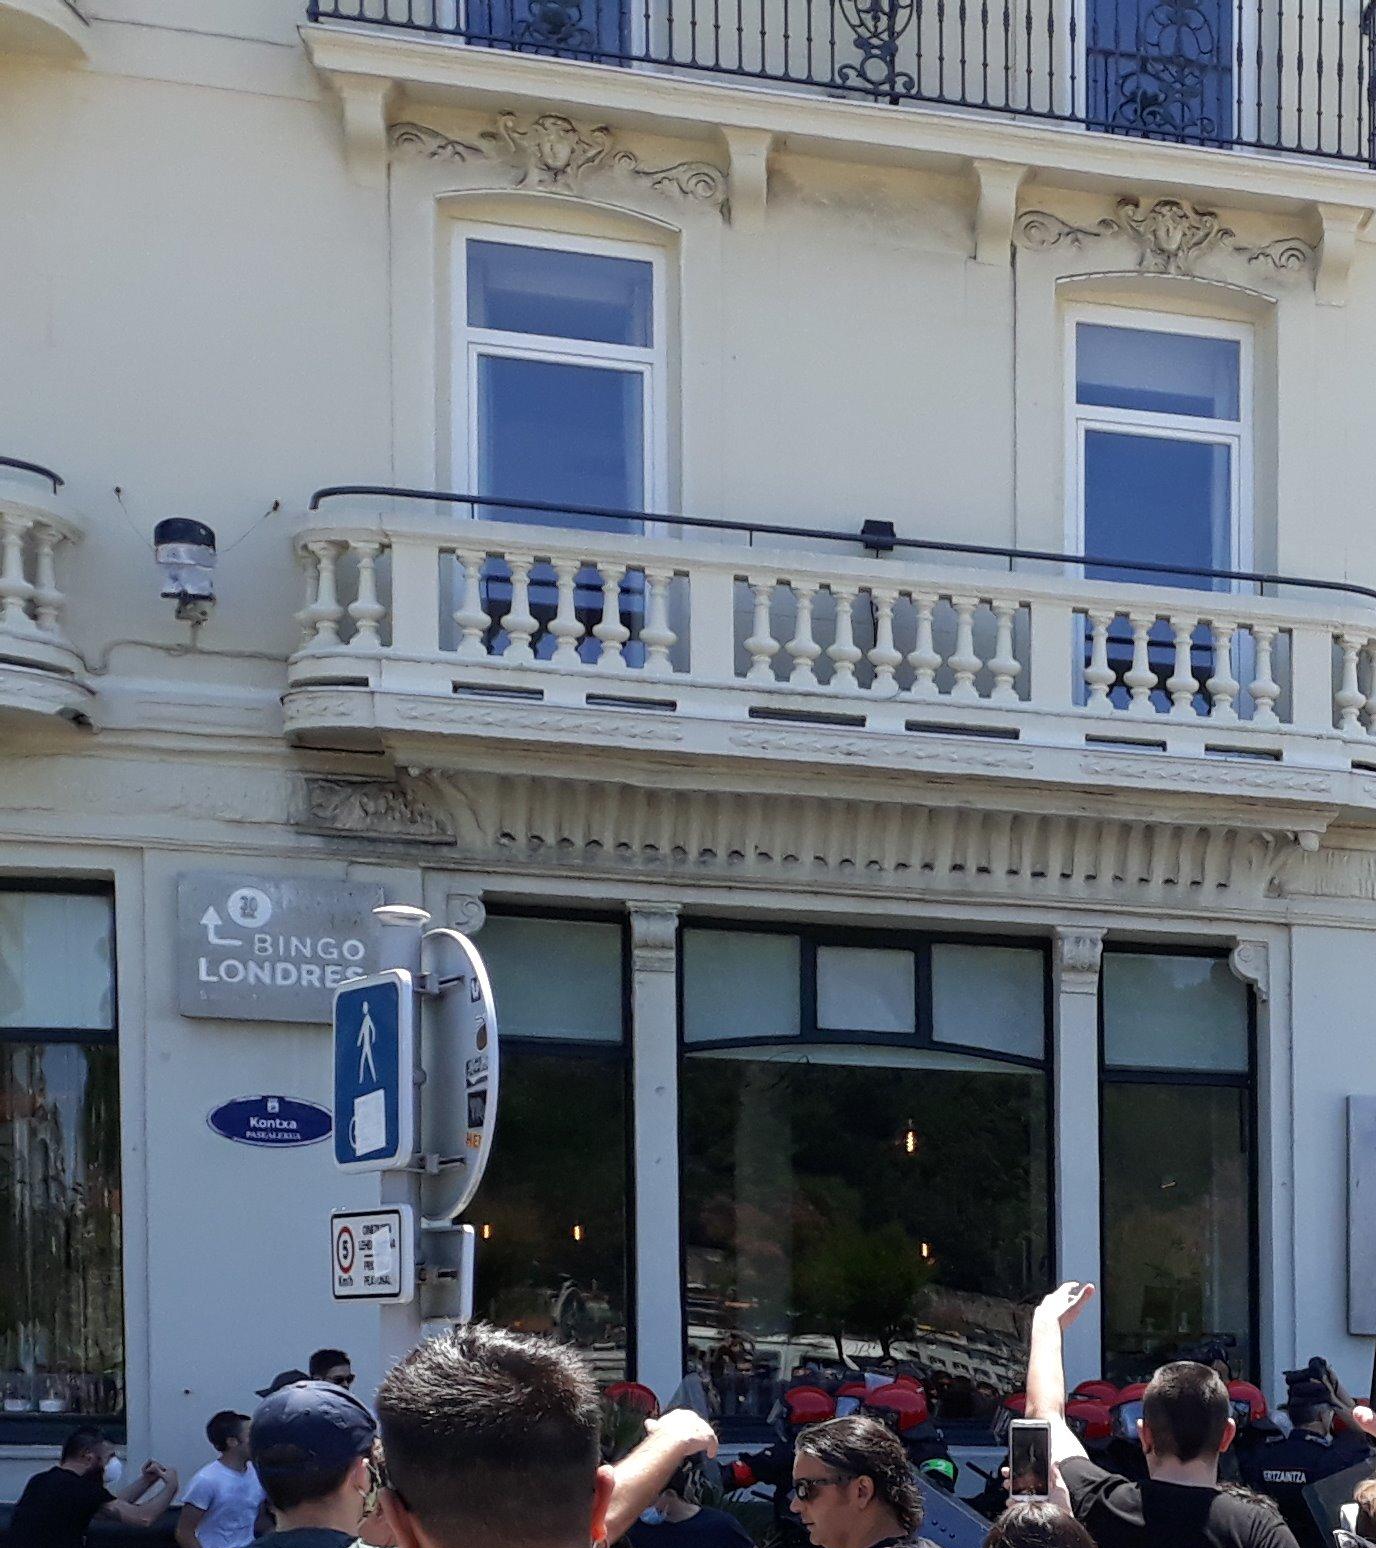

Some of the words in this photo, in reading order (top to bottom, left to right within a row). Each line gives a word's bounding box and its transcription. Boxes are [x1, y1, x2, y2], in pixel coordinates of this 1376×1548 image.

[254, 933, 366, 961] BINGO
[249, 1116, 297, 1129] Kontxa
[342, 1239, 349, 1260] 5
